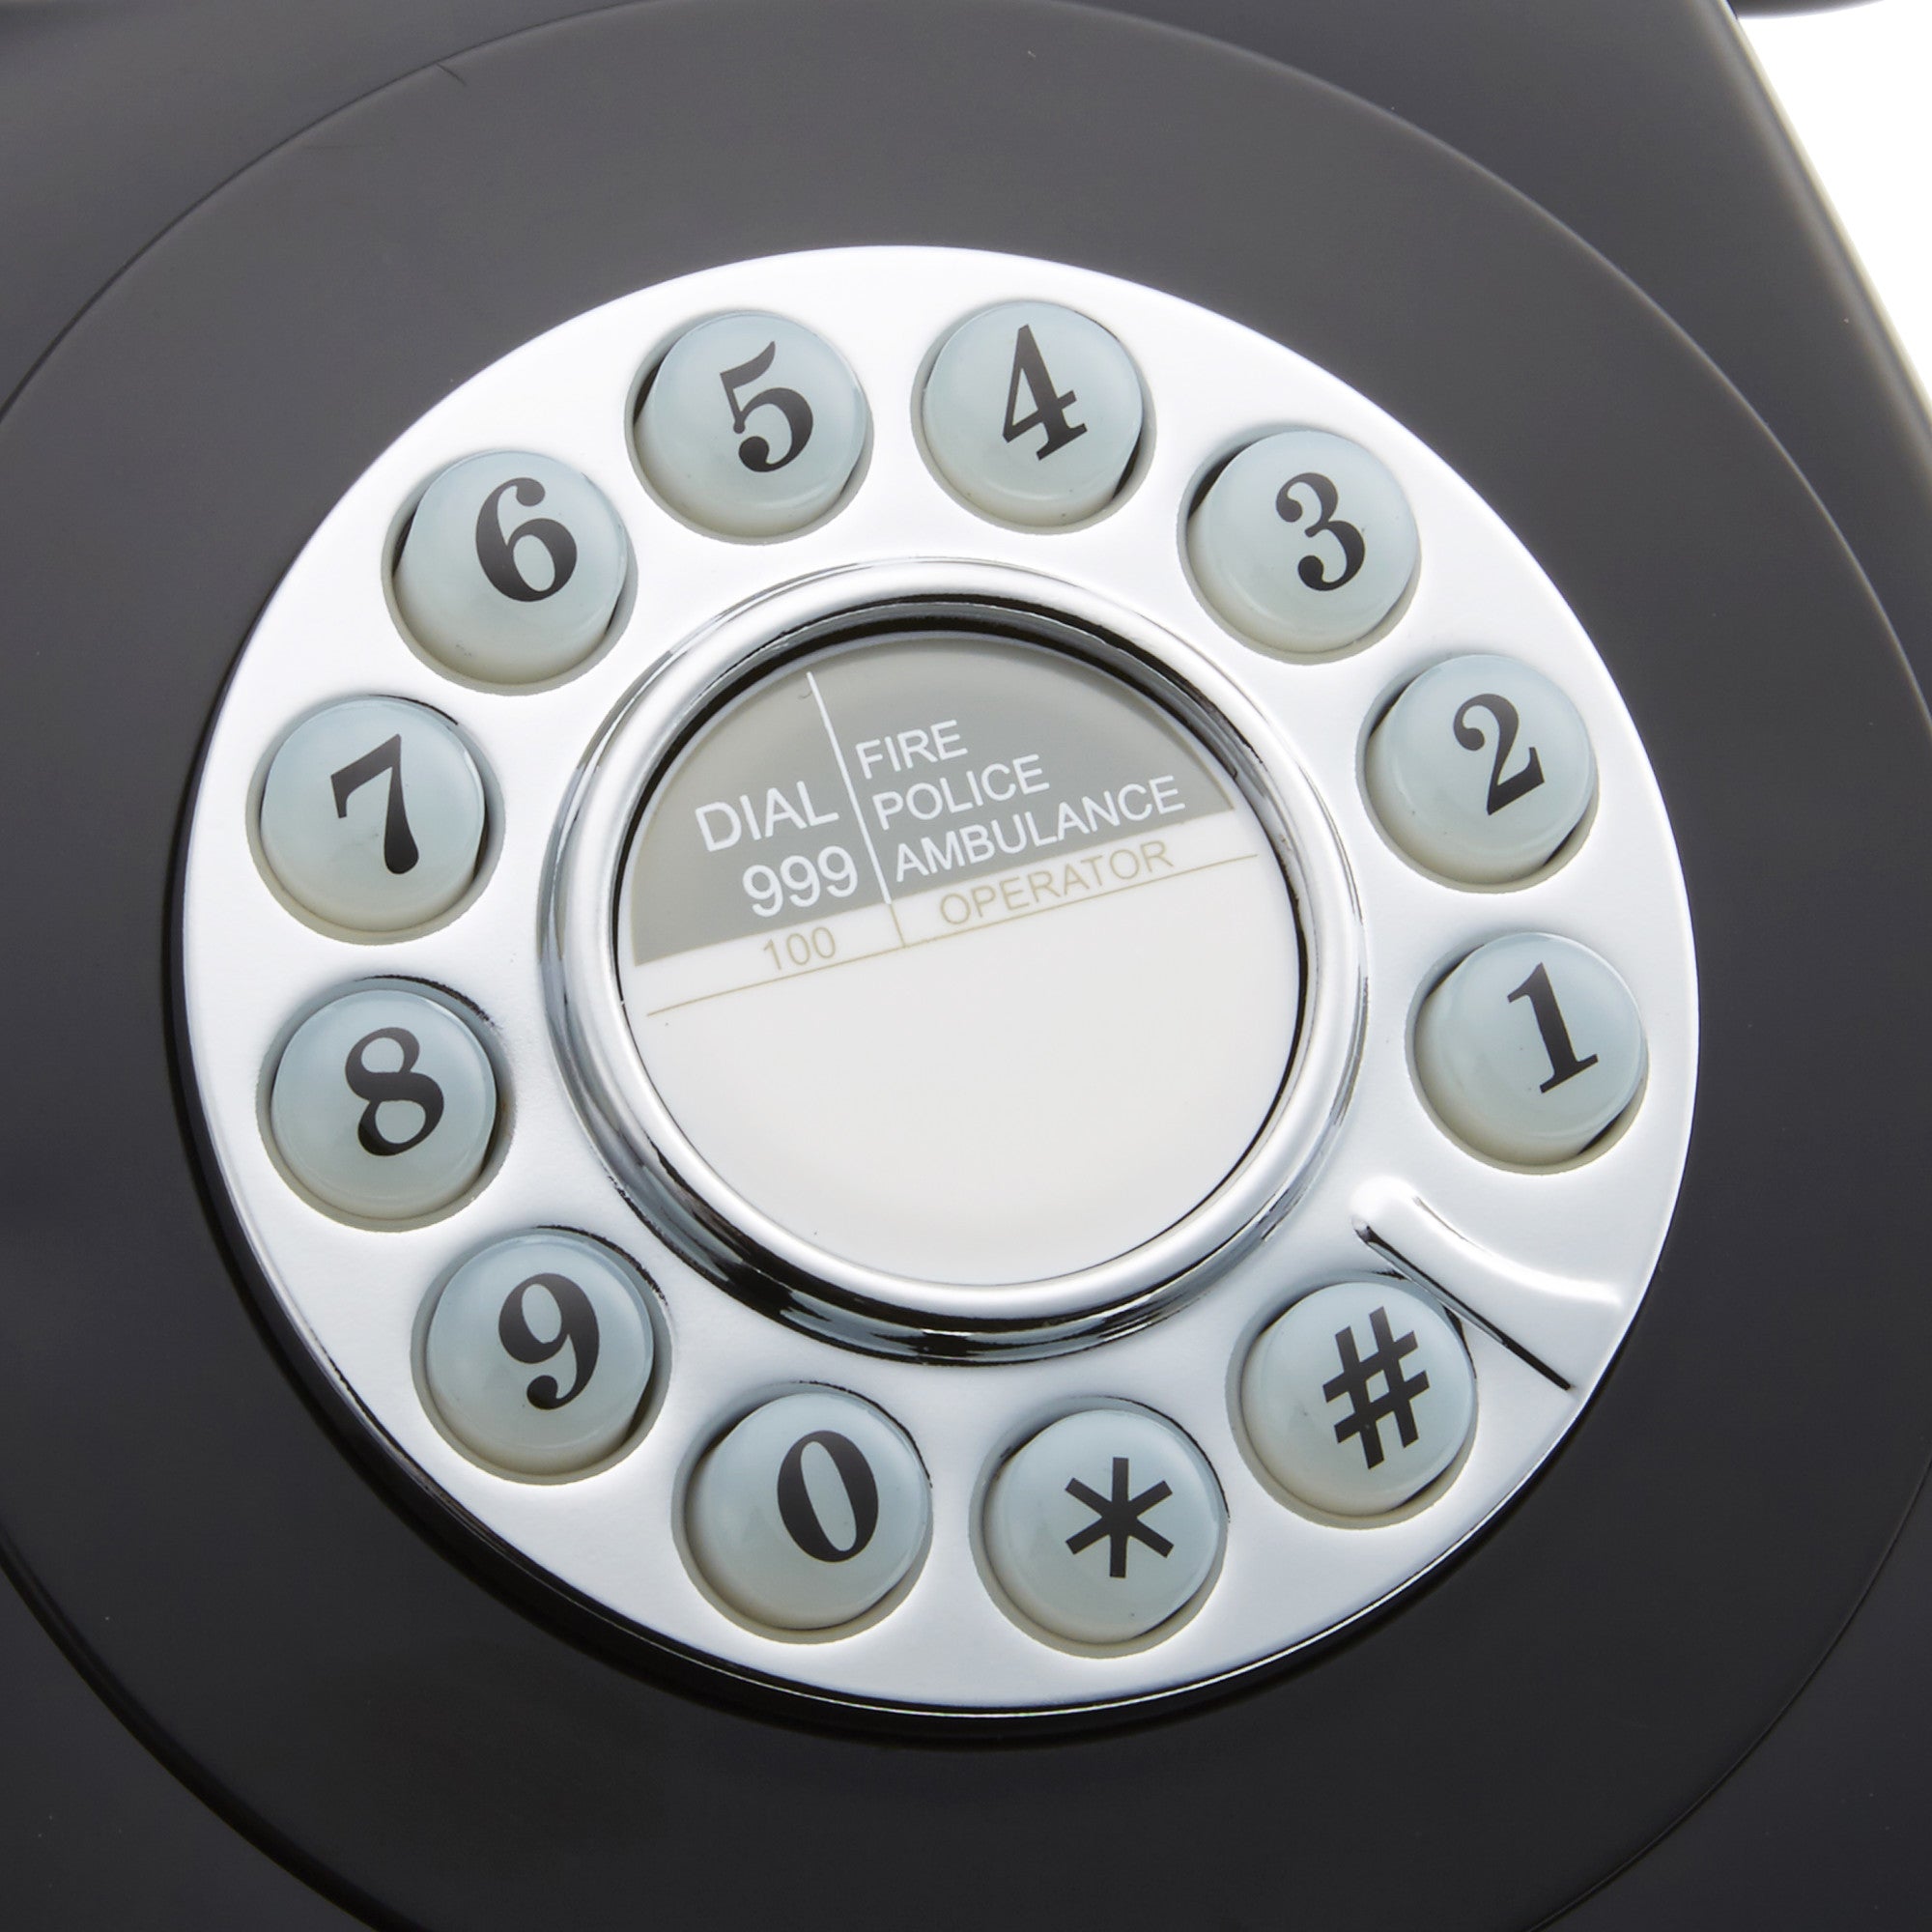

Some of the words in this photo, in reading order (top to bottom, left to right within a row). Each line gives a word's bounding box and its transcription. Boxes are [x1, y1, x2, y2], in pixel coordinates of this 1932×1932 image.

[719, 341, 814, 473] 5
[1002, 324, 1088, 461] 4
[475, 476, 578, 603] 6
[1276, 472, 1365, 592] 3
[331, 733, 420, 875] 7
[856, 719, 968, 779] FIRE
[872, 753, 1050, 830] POLICE
[1453, 694, 1546, 816] 2
[696, 781, 839, 851] DIAL
[895, 775, 1185, 882] AMBULANCE
[742, 846, 860, 918] 999
[939, 838, 1174, 925] OPERATOR
[764, 925, 837, 971] 100
[1506, 965, 1599, 1094] 1
[344, 1027, 445, 1157] 8
[497, 1272, 601, 1410] 9
[1321, 1305, 1431, 1470] #
[776, 1430, 880, 1563] 0
